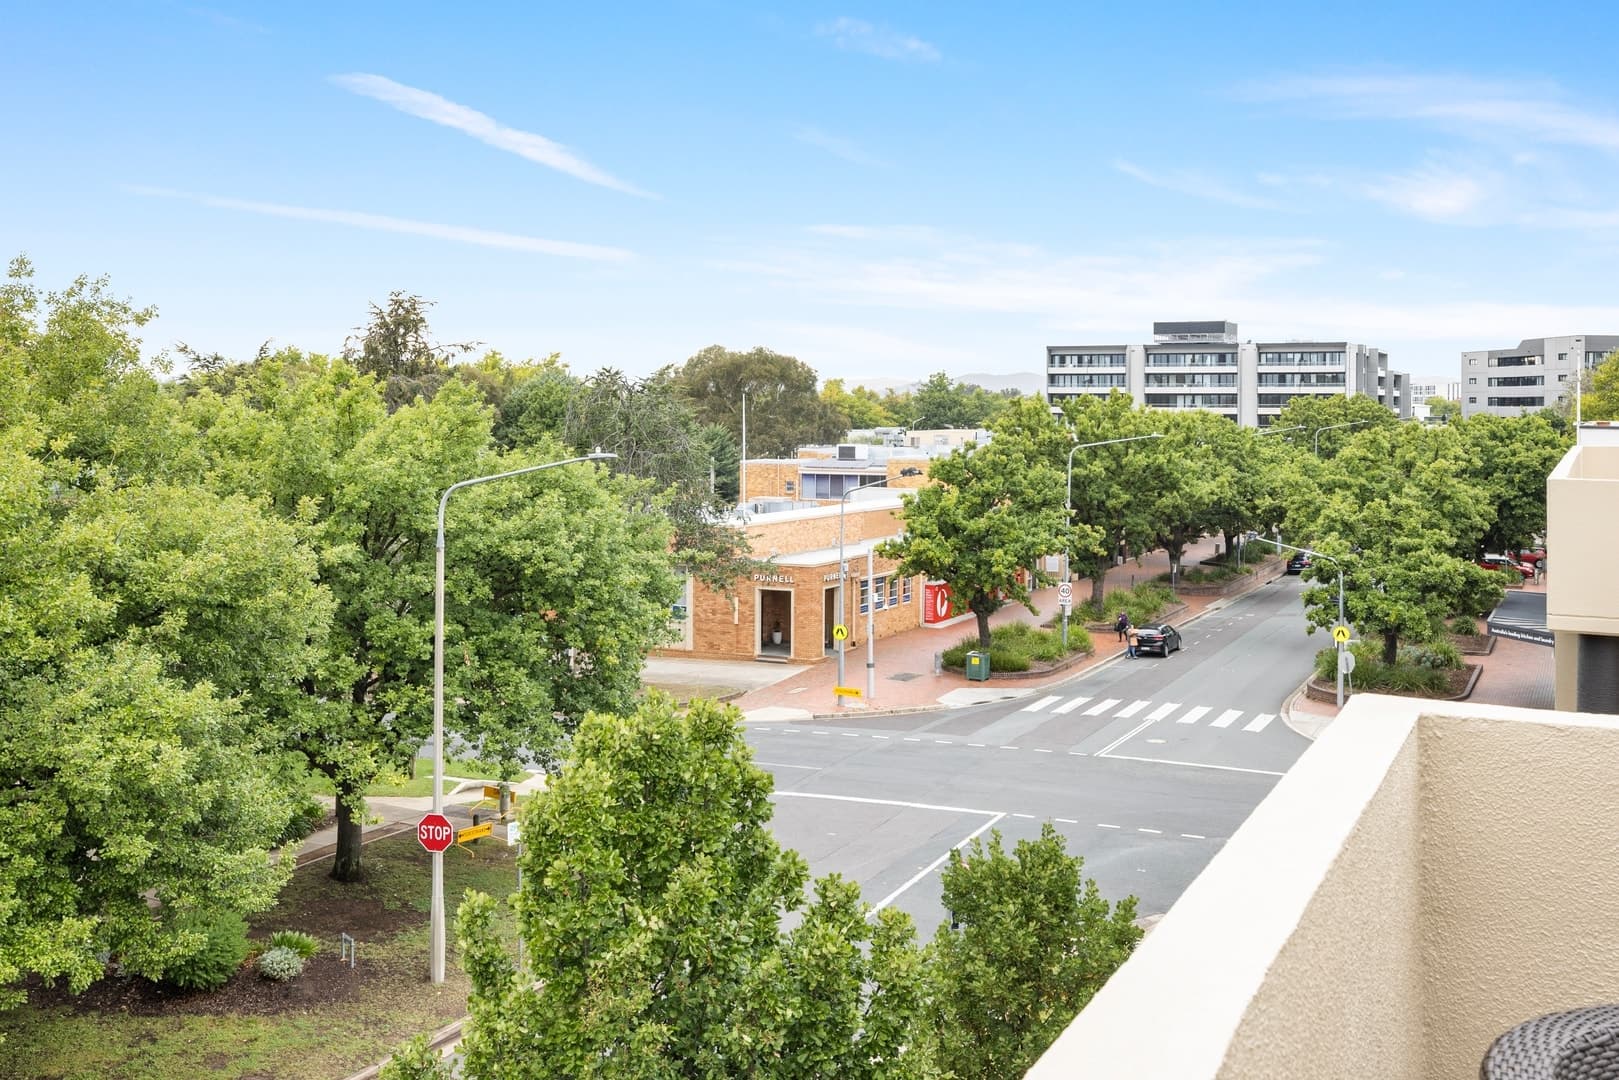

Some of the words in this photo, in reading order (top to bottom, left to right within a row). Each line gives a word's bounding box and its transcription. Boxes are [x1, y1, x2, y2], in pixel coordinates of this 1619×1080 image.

[753, 574, 795, 583] PURNELL
[1060, 587, 1070, 595] 40
[420, 825, 451, 840] STOP
